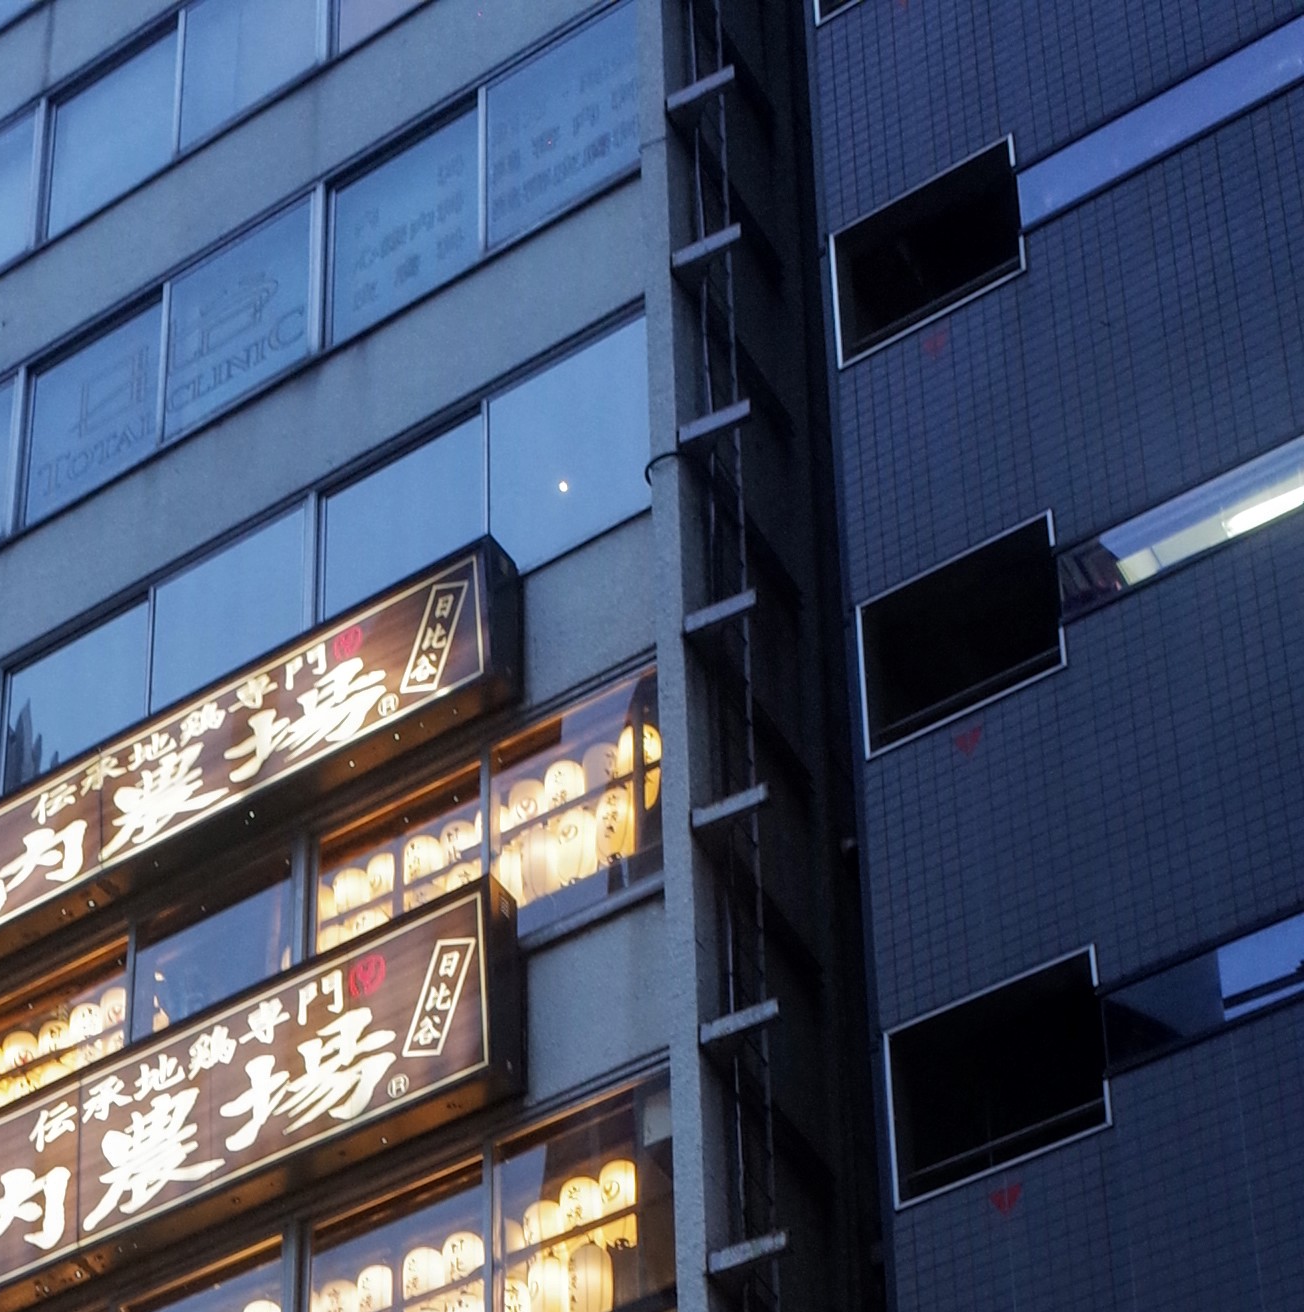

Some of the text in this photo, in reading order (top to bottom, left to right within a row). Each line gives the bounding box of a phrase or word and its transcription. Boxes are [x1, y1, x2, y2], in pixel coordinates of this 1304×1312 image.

[407, 595, 456, 684] 日比谷
[412, 949, 461, 1046] 日比谷
[29, 968, 344, 1153] 伝承地鶏専門
